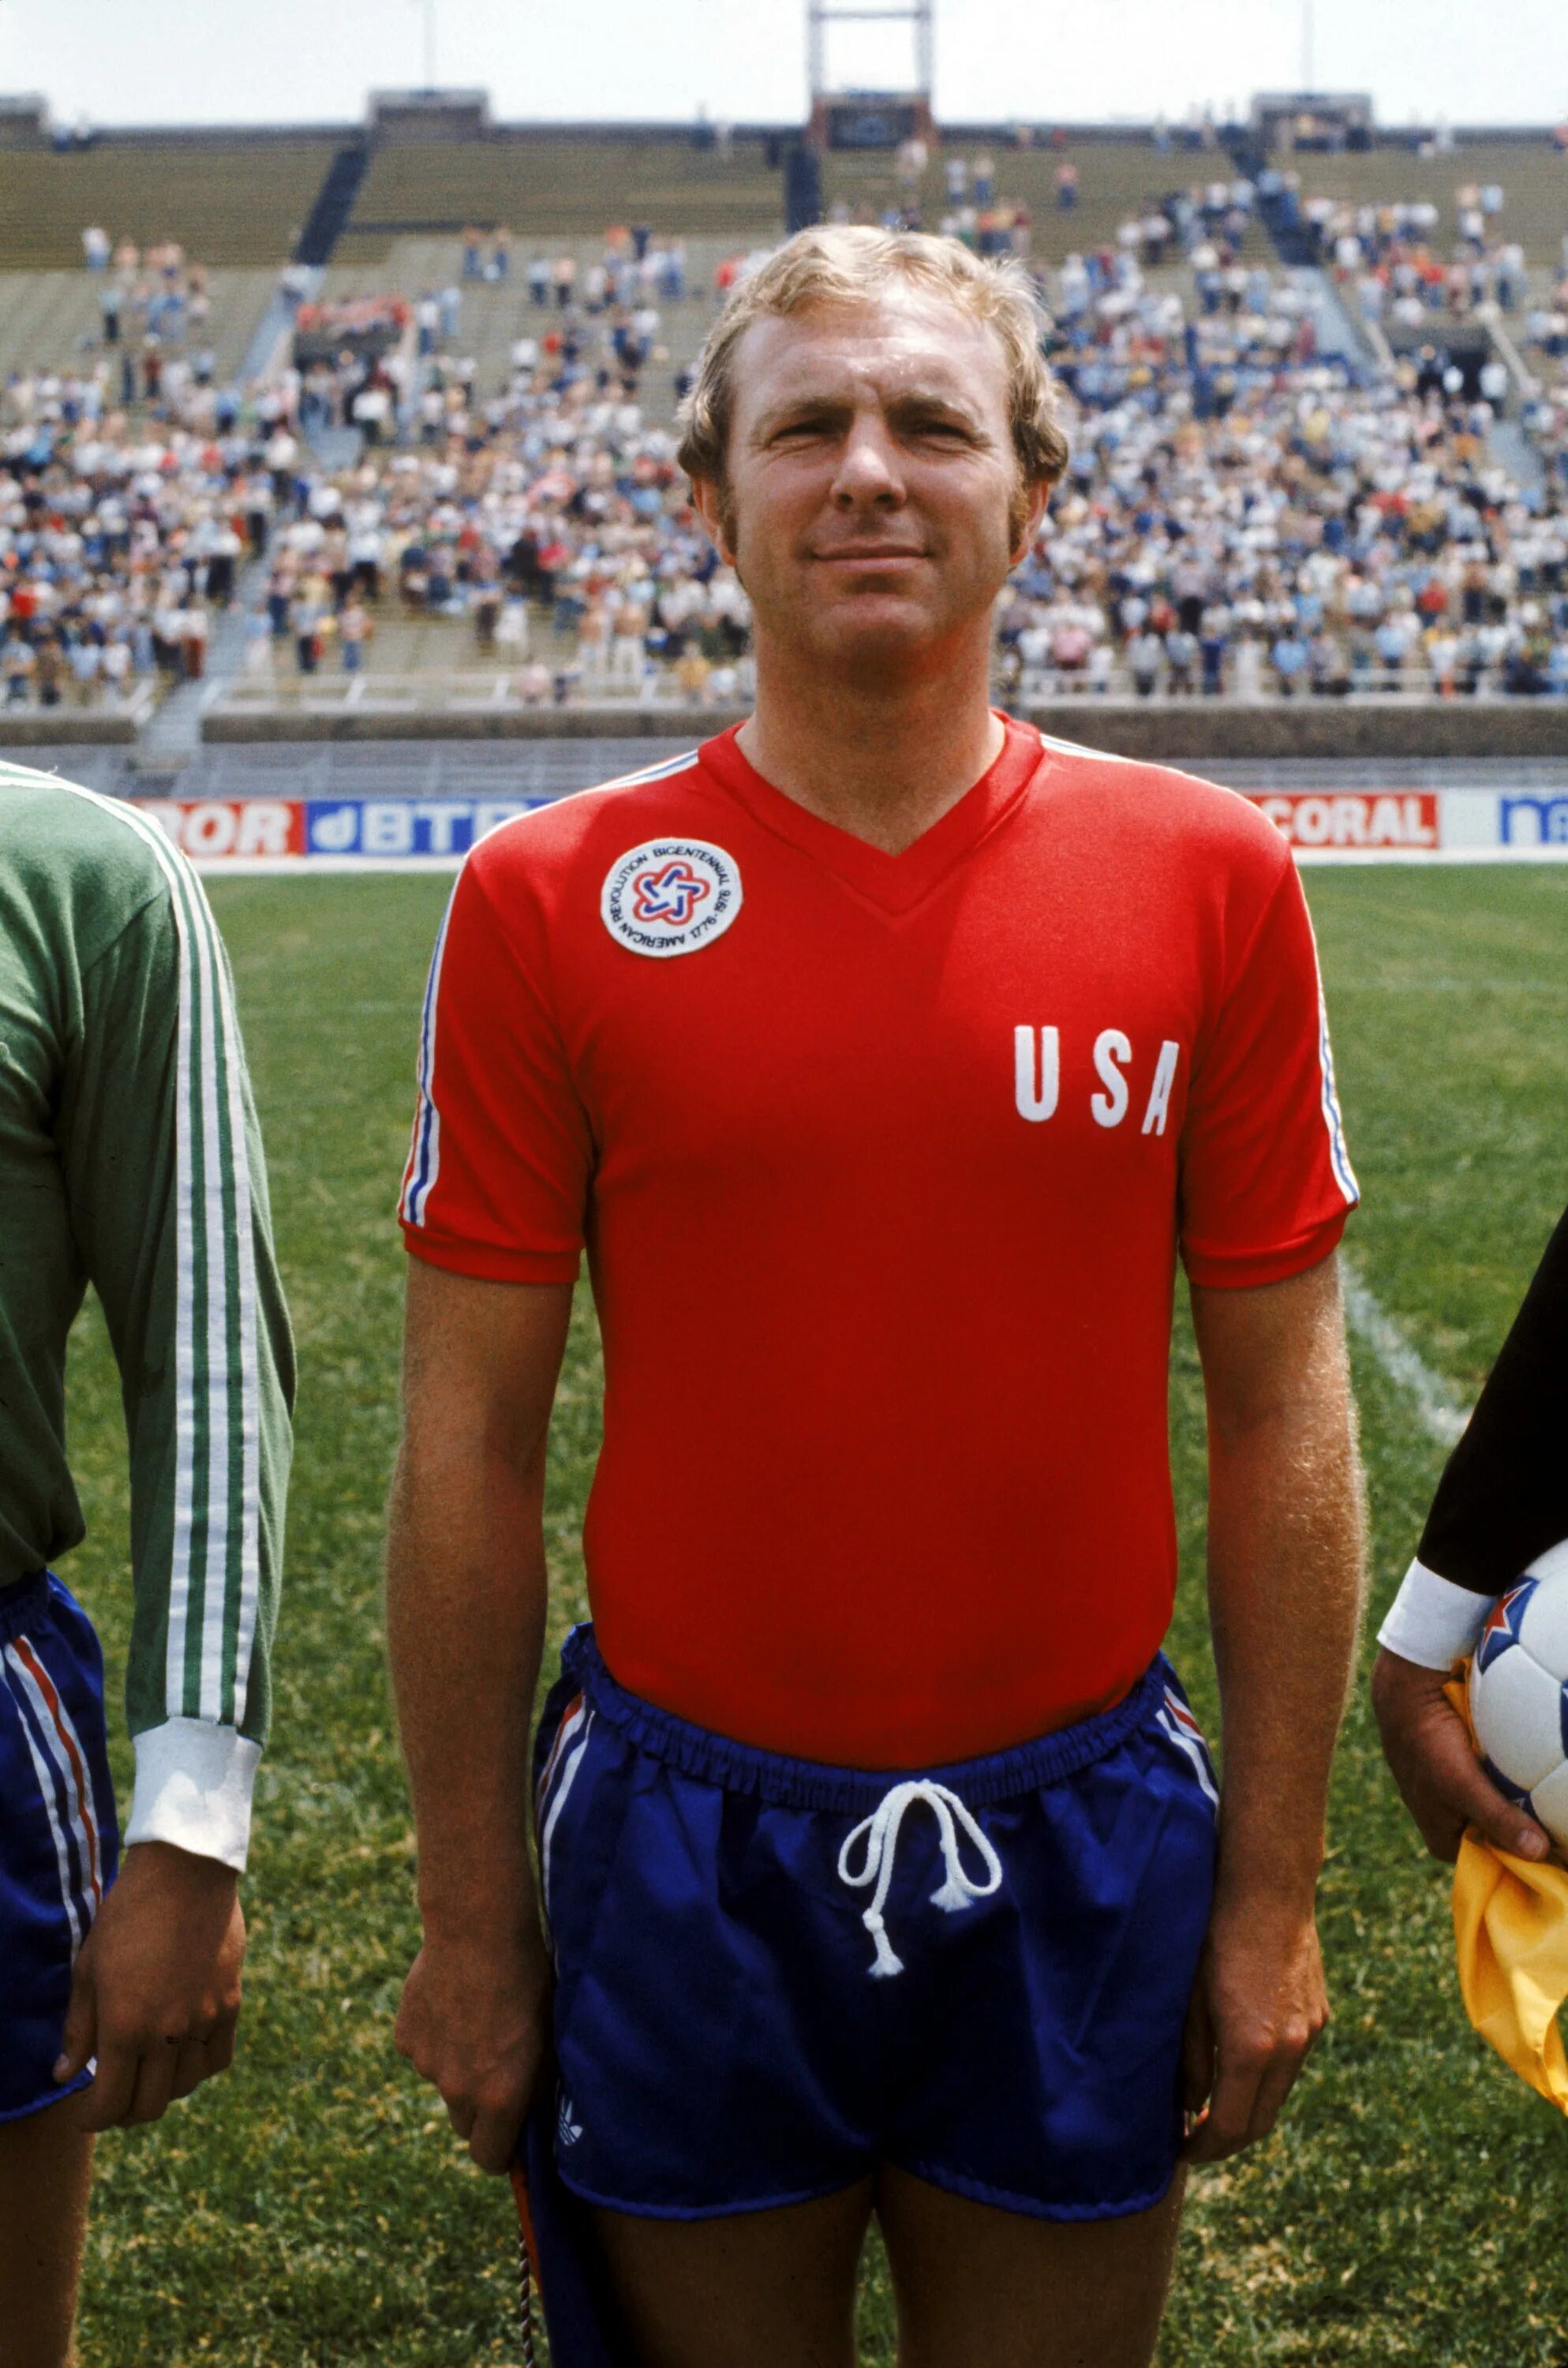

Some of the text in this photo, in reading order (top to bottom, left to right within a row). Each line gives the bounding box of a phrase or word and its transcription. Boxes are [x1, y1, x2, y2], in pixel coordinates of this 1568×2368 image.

[1263, 797, 1432, 845] CORAL
[610, 845, 731, 949] AMERICAN REVOLUTION BICENTENNIAL 1776-1976
[1014, 1025, 1180, 1137] USA
